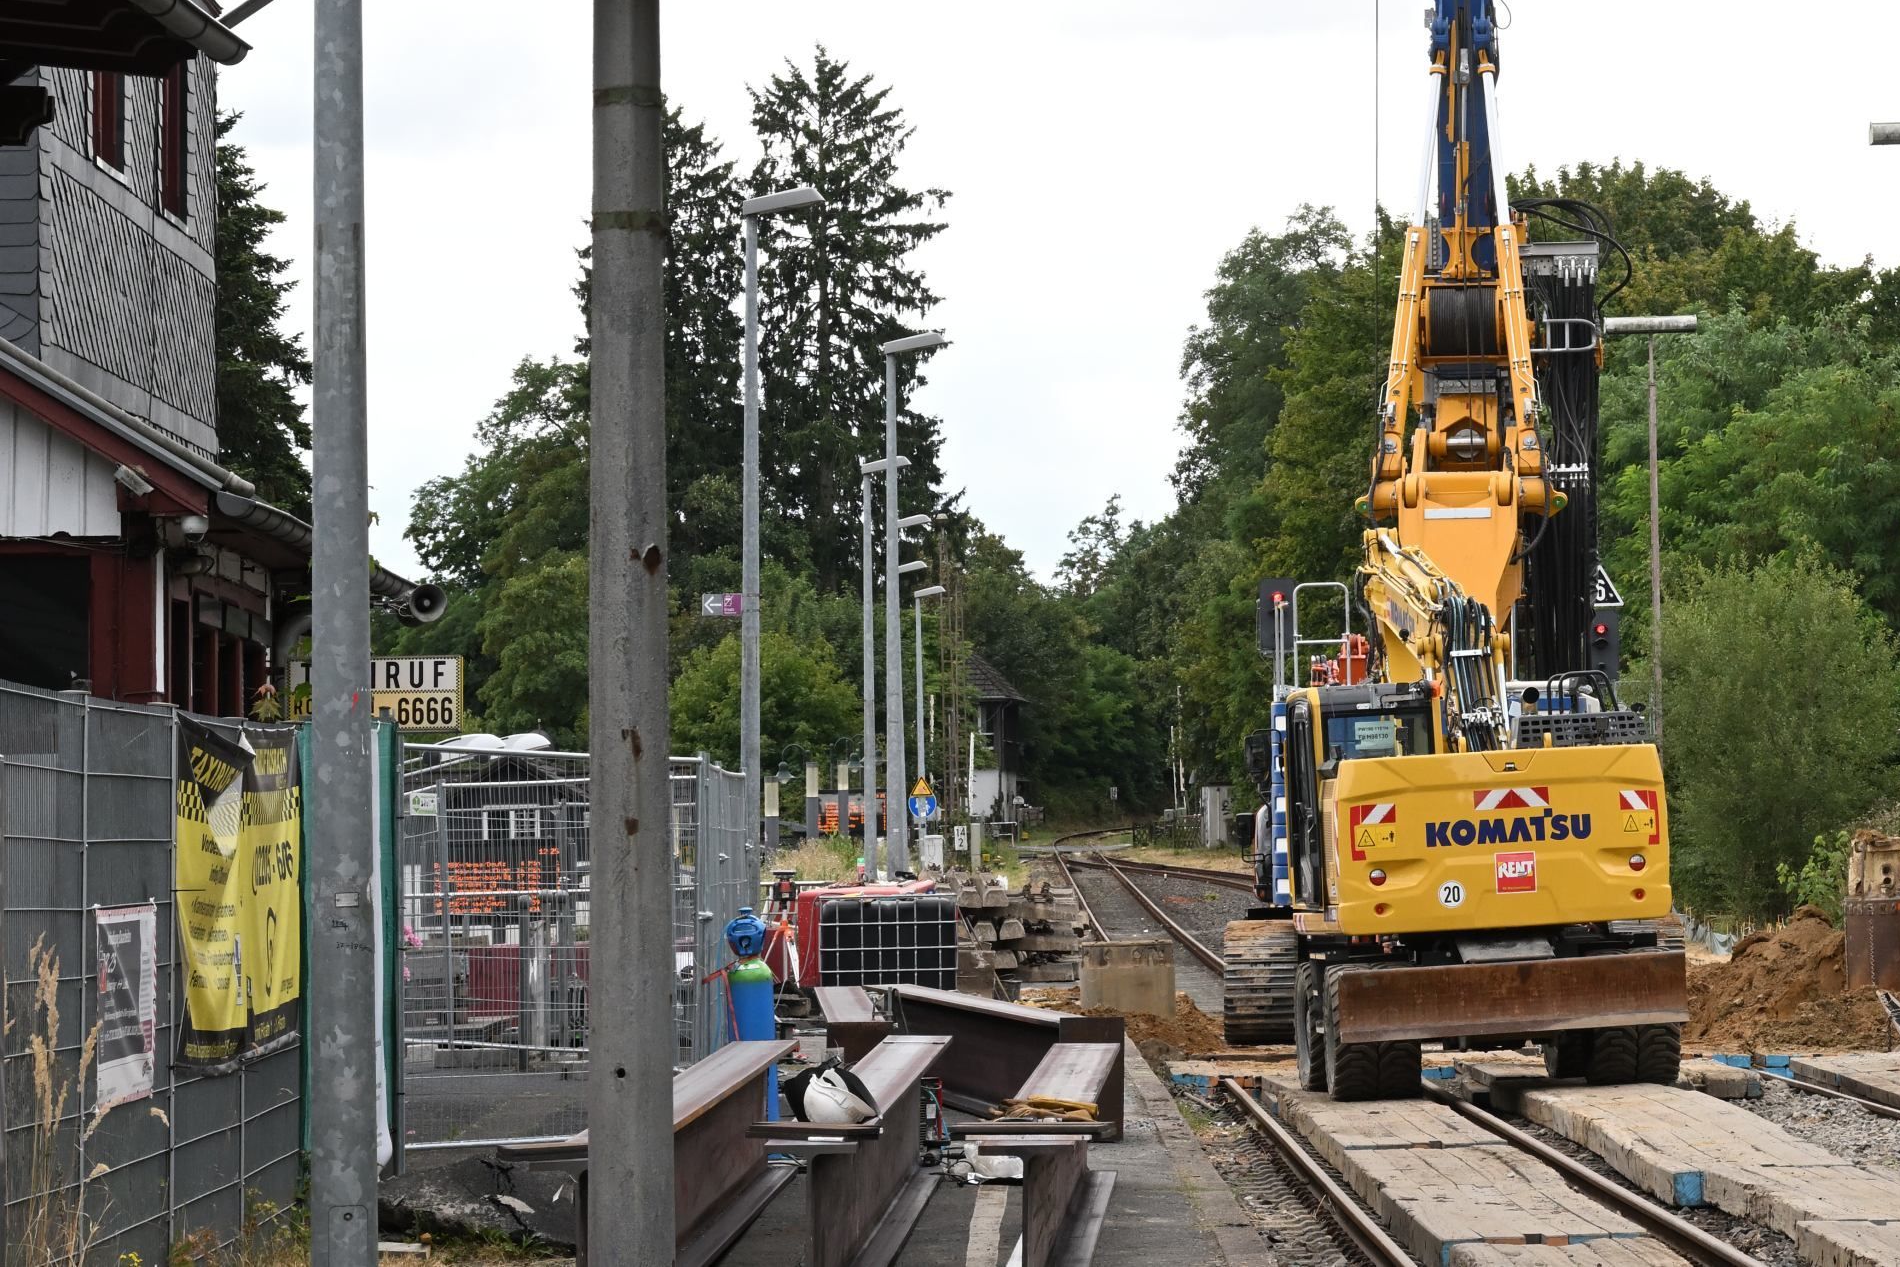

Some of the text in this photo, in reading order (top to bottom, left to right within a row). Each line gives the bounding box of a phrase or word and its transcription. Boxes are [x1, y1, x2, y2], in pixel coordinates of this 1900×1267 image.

[397, 696, 453, 726] 6666
[1426, 808, 1592, 848] KOMATSU
[958, 837, 964, 848] 2
[1498, 860, 1534, 879] RENT
[1443, 885, 1460, 904] 20
